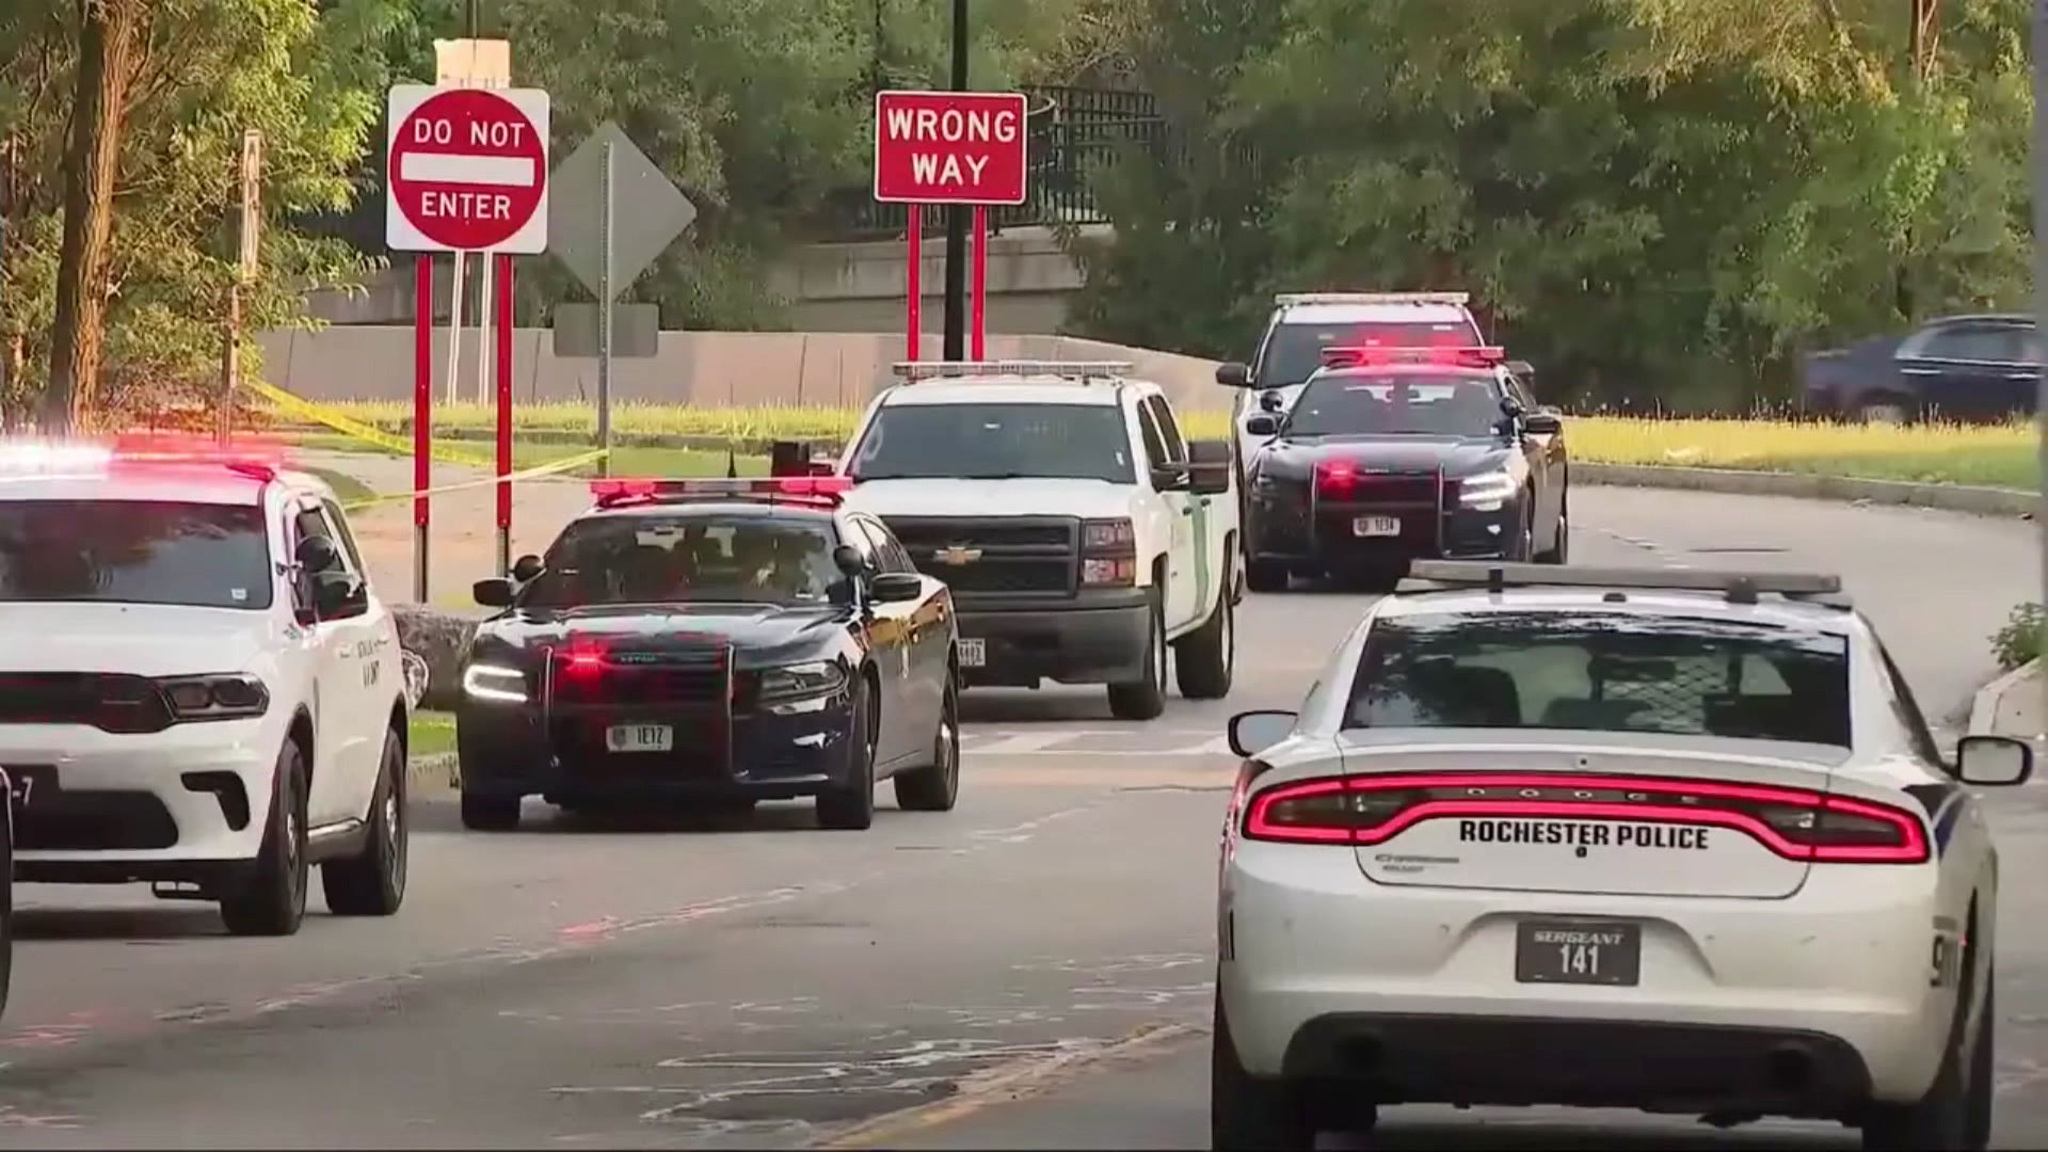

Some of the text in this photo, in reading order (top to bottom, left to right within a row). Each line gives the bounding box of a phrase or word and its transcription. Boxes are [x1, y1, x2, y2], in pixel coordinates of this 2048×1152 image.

[414, 118, 526, 148] DO NOT
[887, 107, 1017, 143] WRONG
[912, 152, 990, 187] WAY
[421, 191, 512, 220] ENTER
[1460, 820, 1709, 850] ROCHESTER POLICE
[1534, 930, 1624, 945] SERGEANT
[1560, 943, 1598, 975] 141
